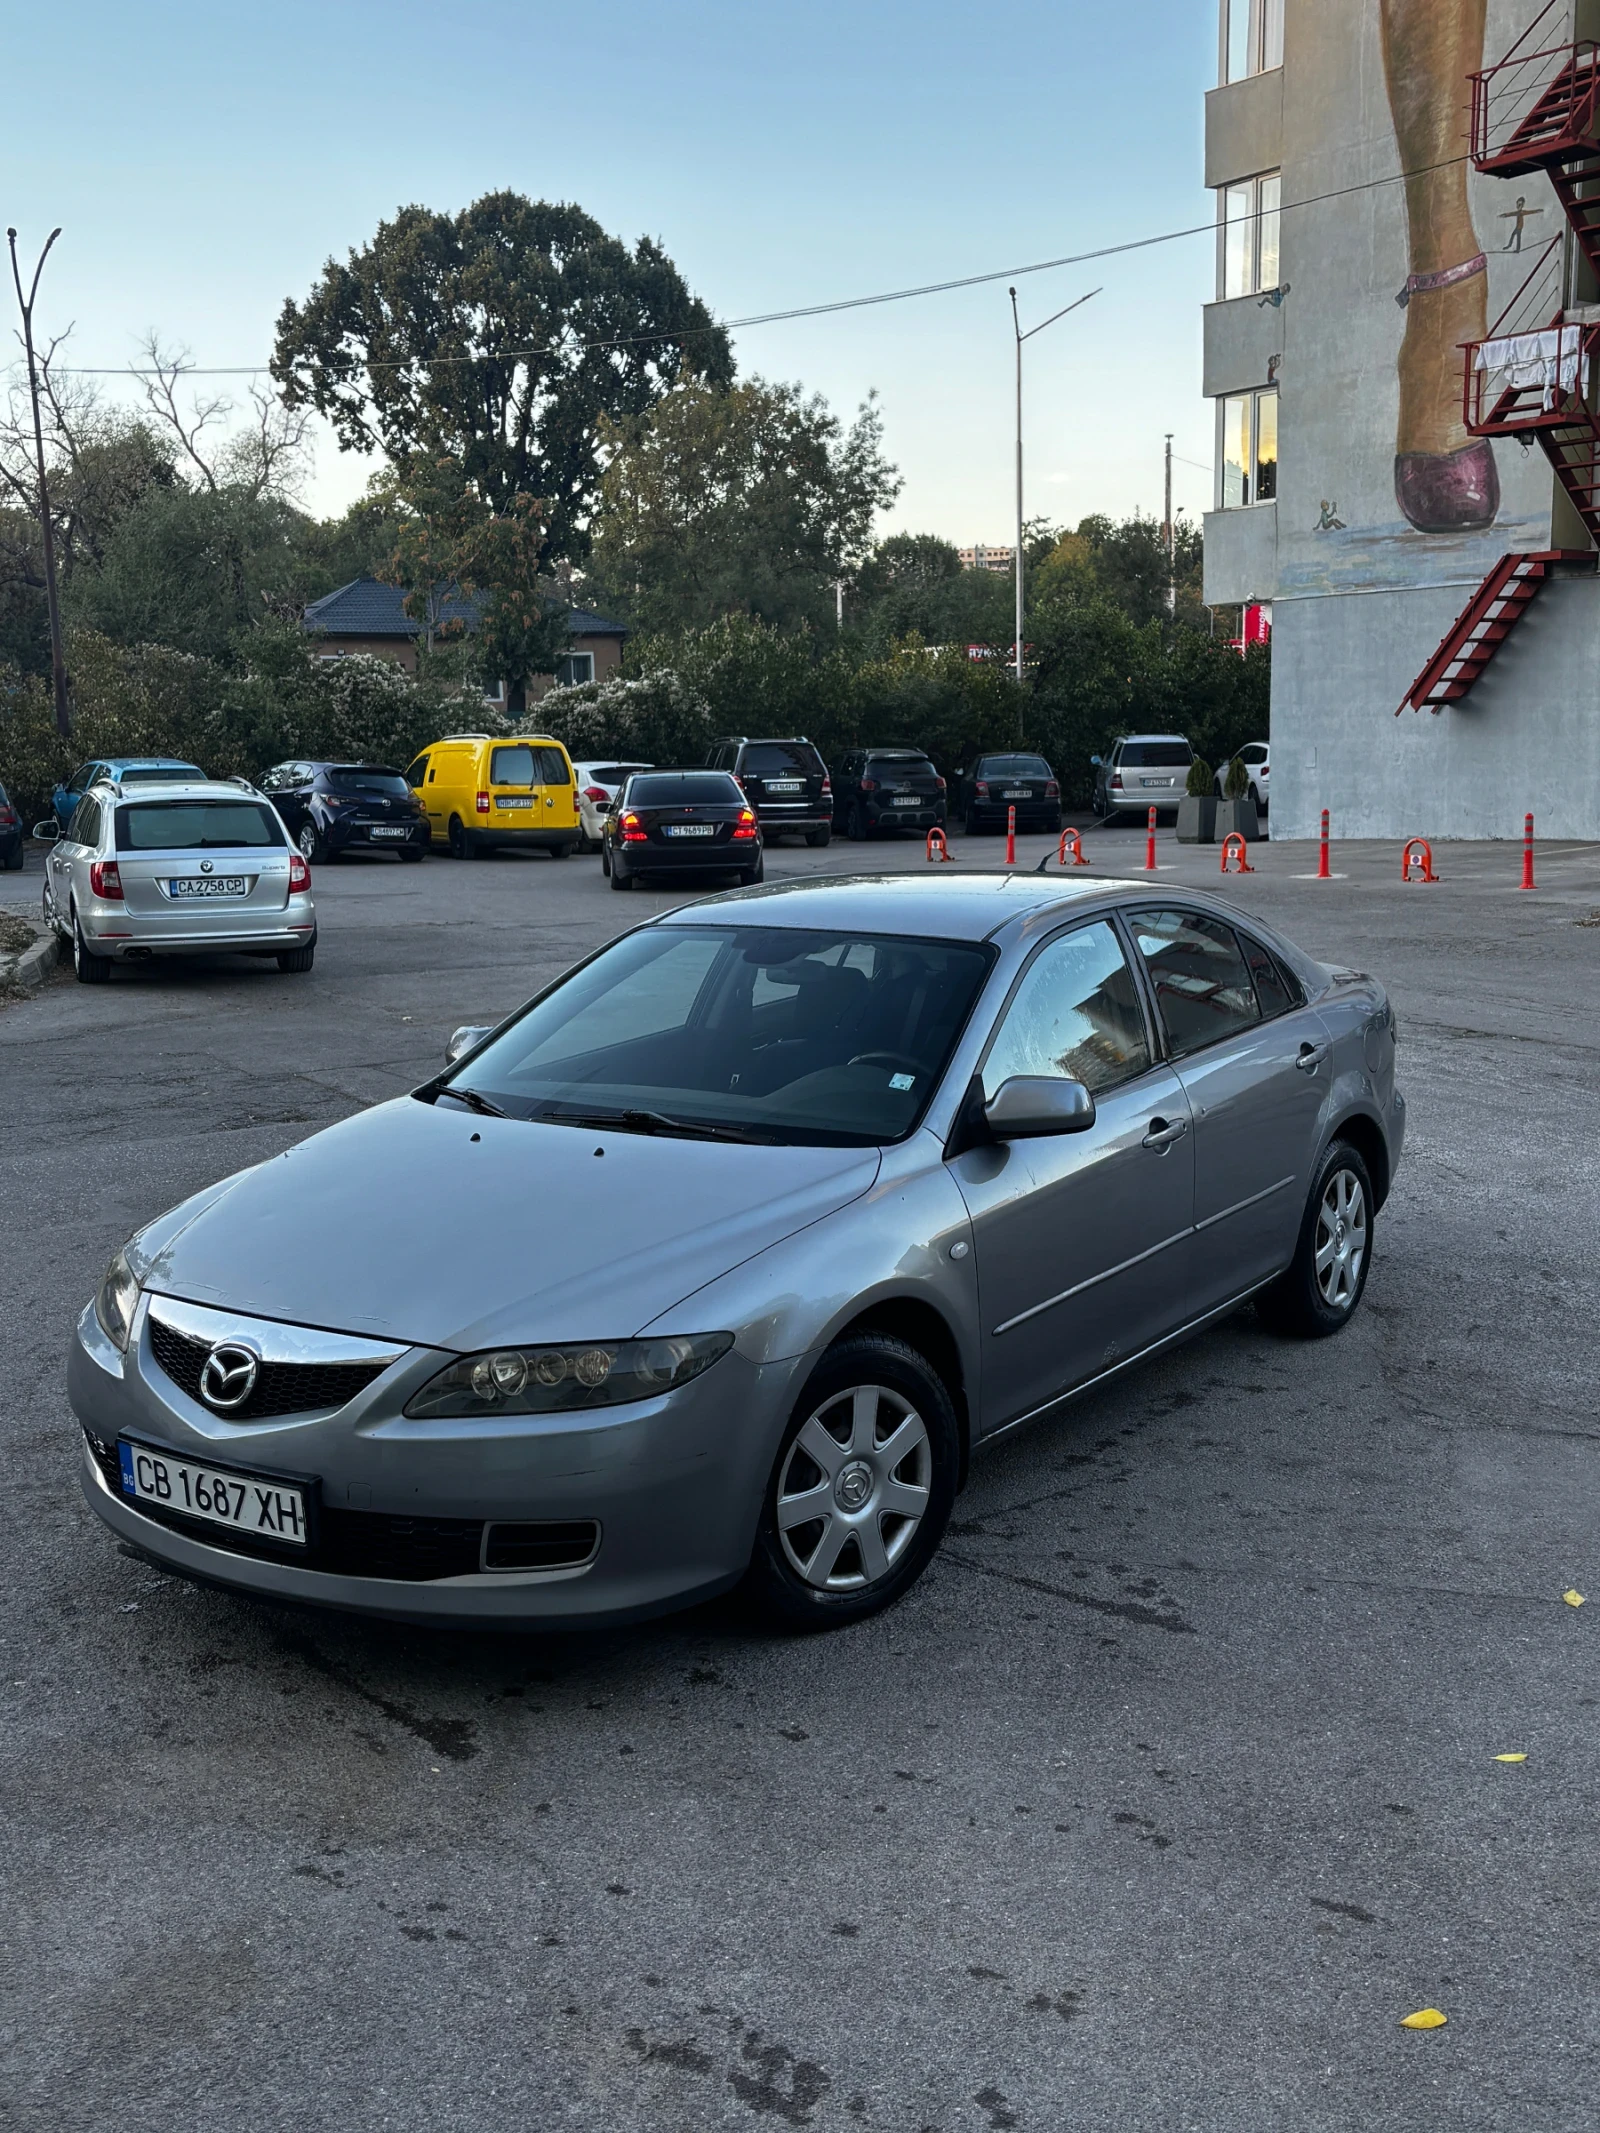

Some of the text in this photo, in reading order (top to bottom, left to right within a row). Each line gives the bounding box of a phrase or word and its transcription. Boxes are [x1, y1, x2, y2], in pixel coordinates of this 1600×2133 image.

[178, 881, 193, 892] CA
[196, 880, 225, 892] 2758
[226, 879, 242, 891] CP
[123, 1473, 135, 1487] BG
[136, 1454, 300, 1536] CB 1687 XH
